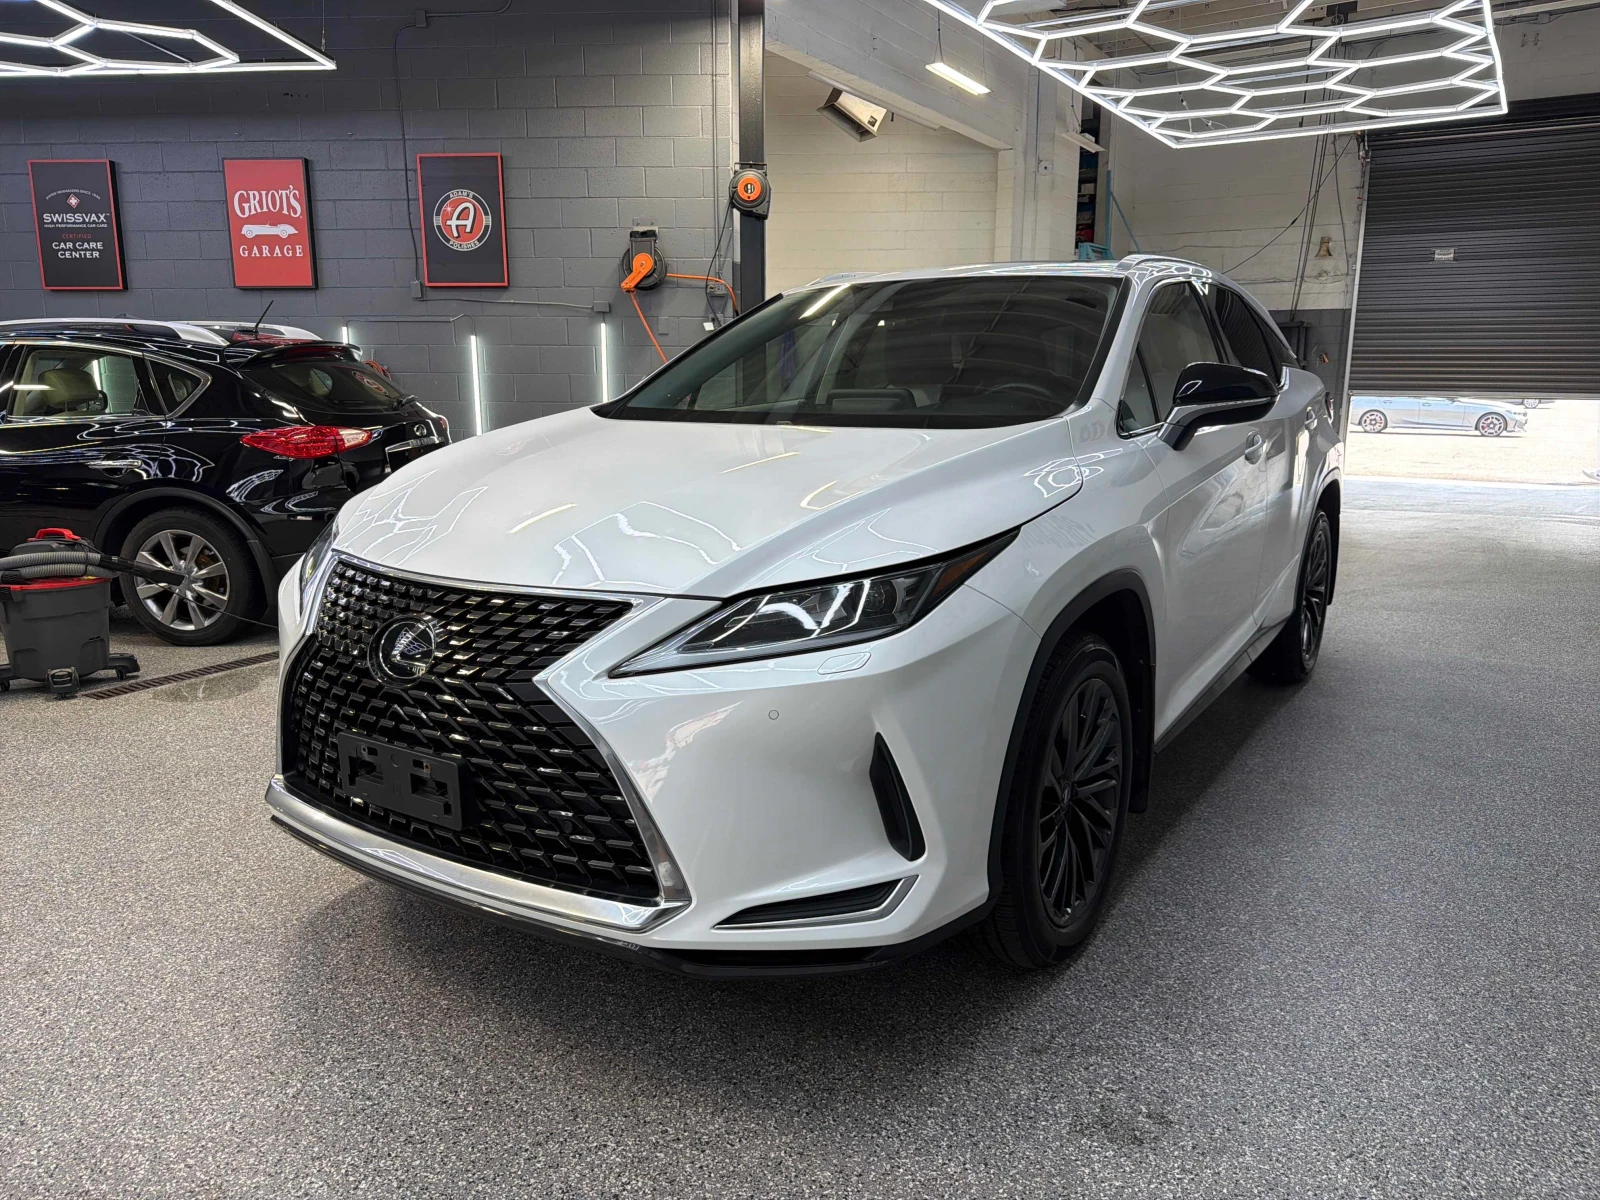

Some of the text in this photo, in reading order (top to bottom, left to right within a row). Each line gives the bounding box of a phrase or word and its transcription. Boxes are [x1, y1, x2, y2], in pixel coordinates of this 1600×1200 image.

[449, 190, 474, 199] ADAM'S
[233, 185, 302, 218] GRIOT'S
[43, 213, 107, 223] SWISSVAX
[75, 241, 104, 249] CARE
[448, 239, 480, 250] POLISHES
[239, 245, 304, 257] GARAGE
